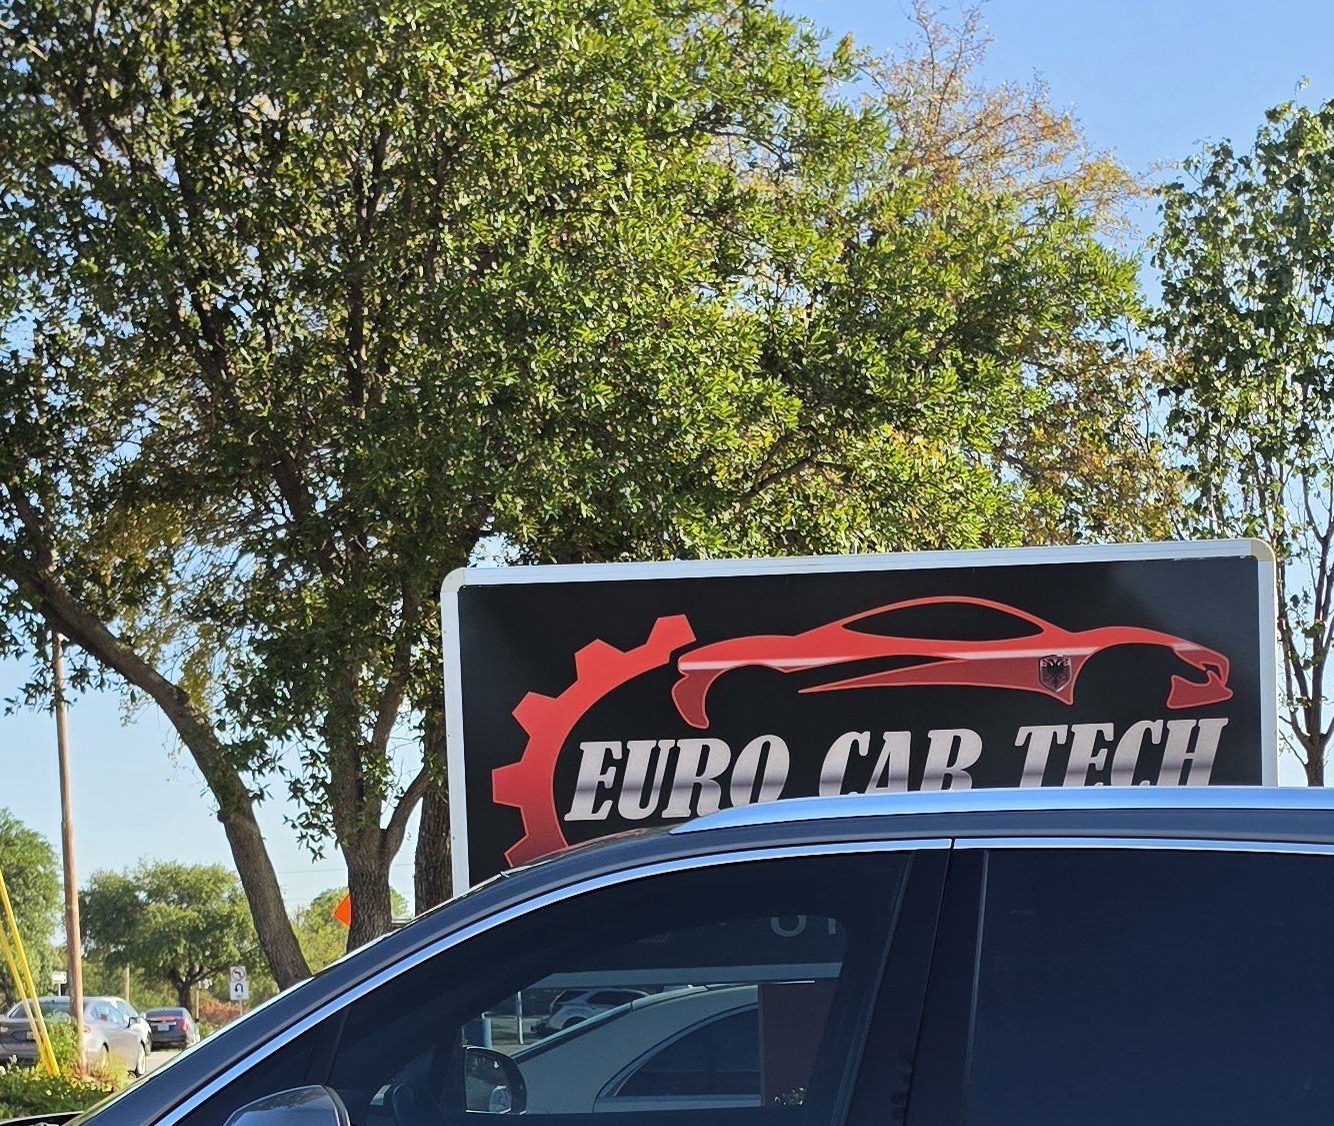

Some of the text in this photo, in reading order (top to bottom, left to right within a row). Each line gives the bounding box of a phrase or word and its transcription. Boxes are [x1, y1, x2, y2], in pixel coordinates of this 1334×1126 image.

[564, 717, 1229, 822] EURO CAR TECH
